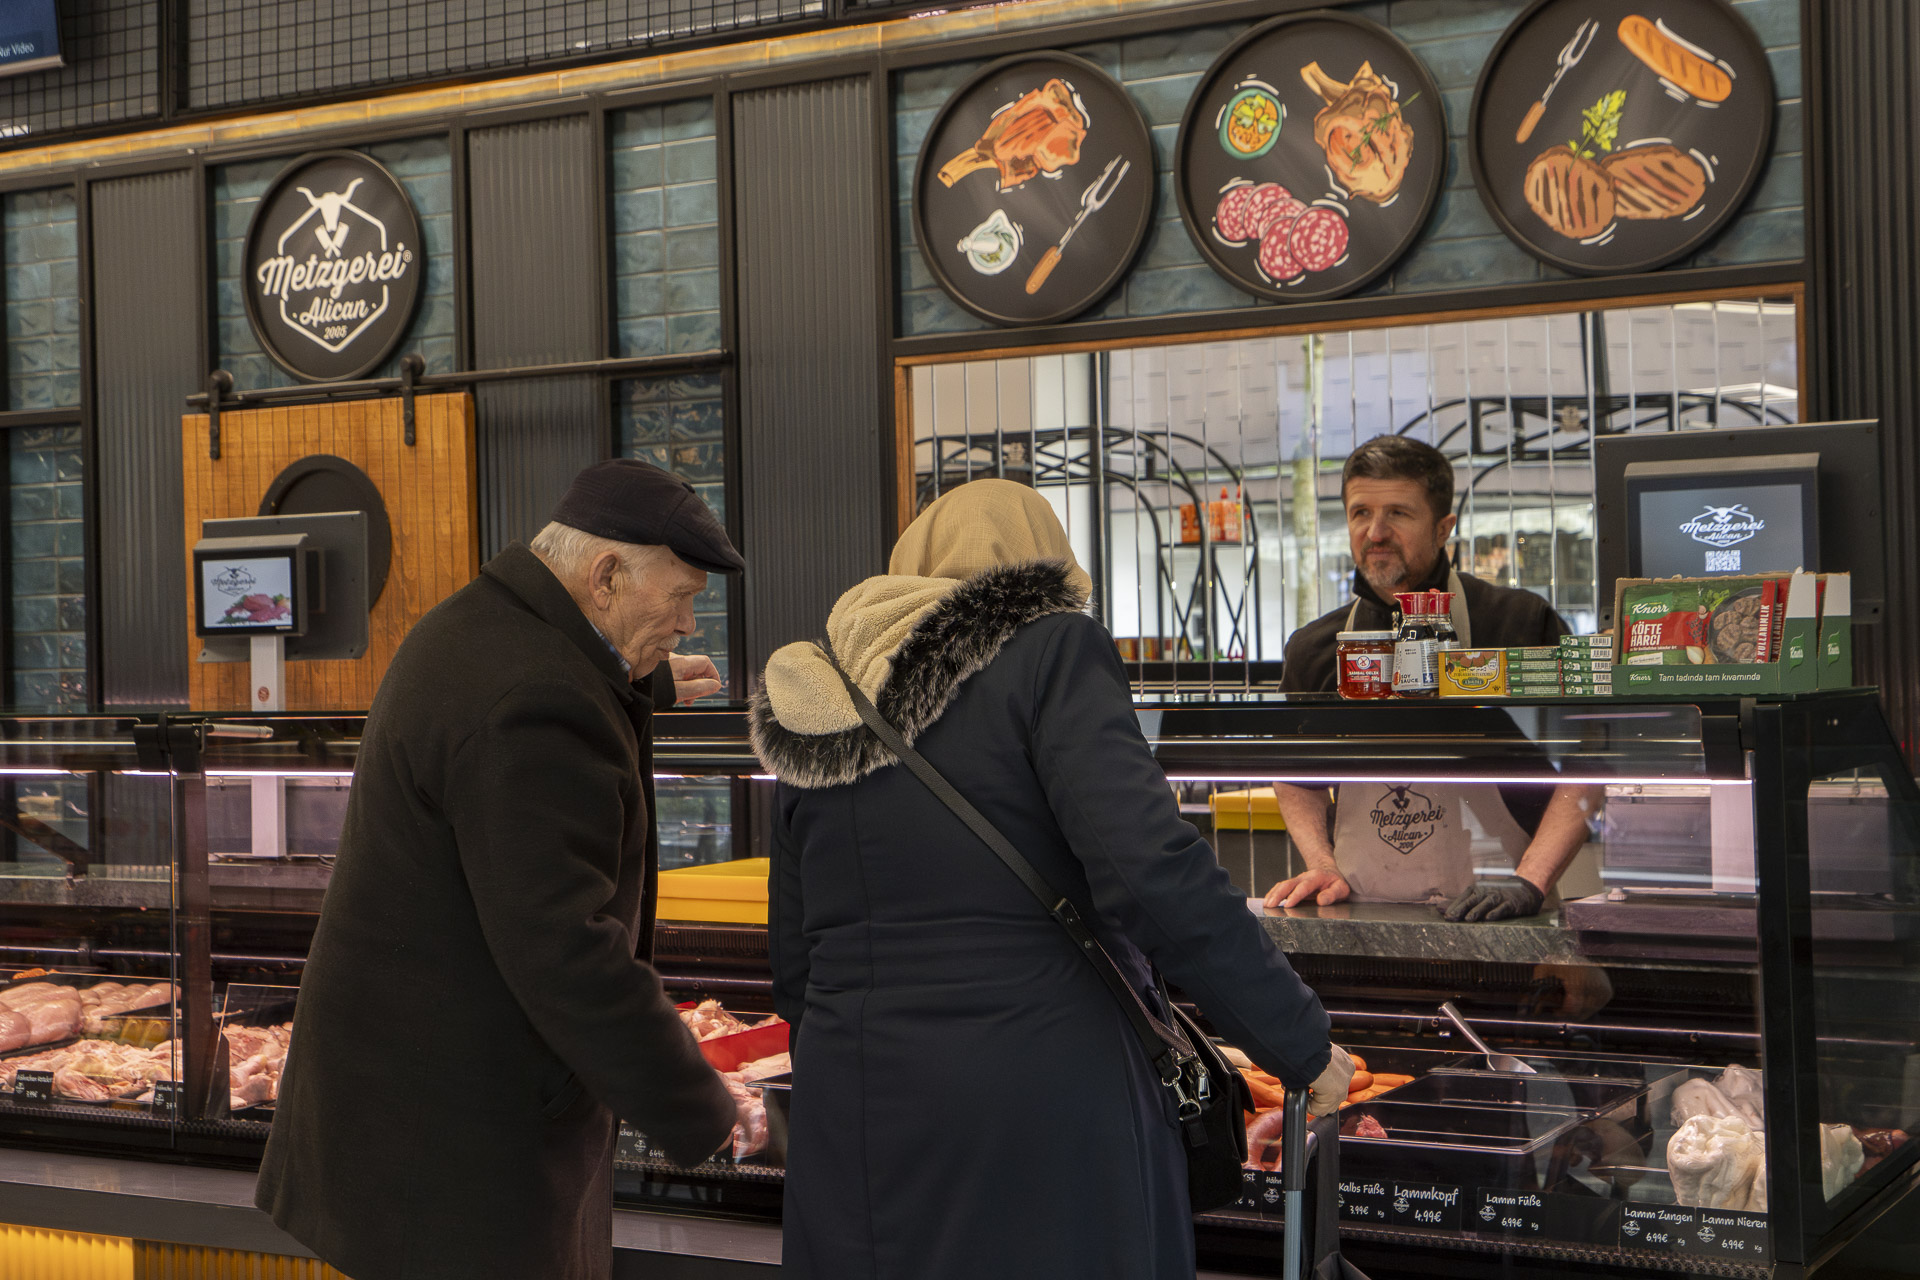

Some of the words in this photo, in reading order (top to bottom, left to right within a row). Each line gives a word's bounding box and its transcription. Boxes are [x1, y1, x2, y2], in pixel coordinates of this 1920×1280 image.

[11, 42, 35, 55] Video
[299, 296, 369, 327] Alican
[1679, 520, 1765, 534] Metzgerei
[1631, 602, 1670, 614] Knorr
[1631, 621, 1663, 635] KÖFTE
[1630, 634, 1661, 647] HARCI
[1629, 673, 1652, 682] Knorr
[1658, 673, 1674, 682] Tam
[1705, 674, 1720, 682] tam
[1370, 805, 1443, 830] Metzgerei
[1388, 830, 1423, 842] Alican
[1339, 1182, 1361, 1194] Kalbs
[1363, 1182, 1385, 1195] Füße
[1394, 1185, 1459, 1207] Lammkopf
[1486, 1193, 1516, 1205] Lamm
[1518, 1194, 1542, 1207] Füße
[1350, 1205, 1369, 1215] 3.99€
[1414, 1209, 1442, 1223] 4.99€
[1625, 1207, 1656, 1219] Lamm
[1657, 1210, 1693, 1225] Zungen
[1501, 1217, 1523, 1228] 6.99€
[1702, 1214, 1735, 1226] Lamm
[1737, 1217, 1767, 1229] Nieren
[1646, 1232, 1668, 1243] 6.99€
[1721, 1239, 1744, 1250] 6.99€
